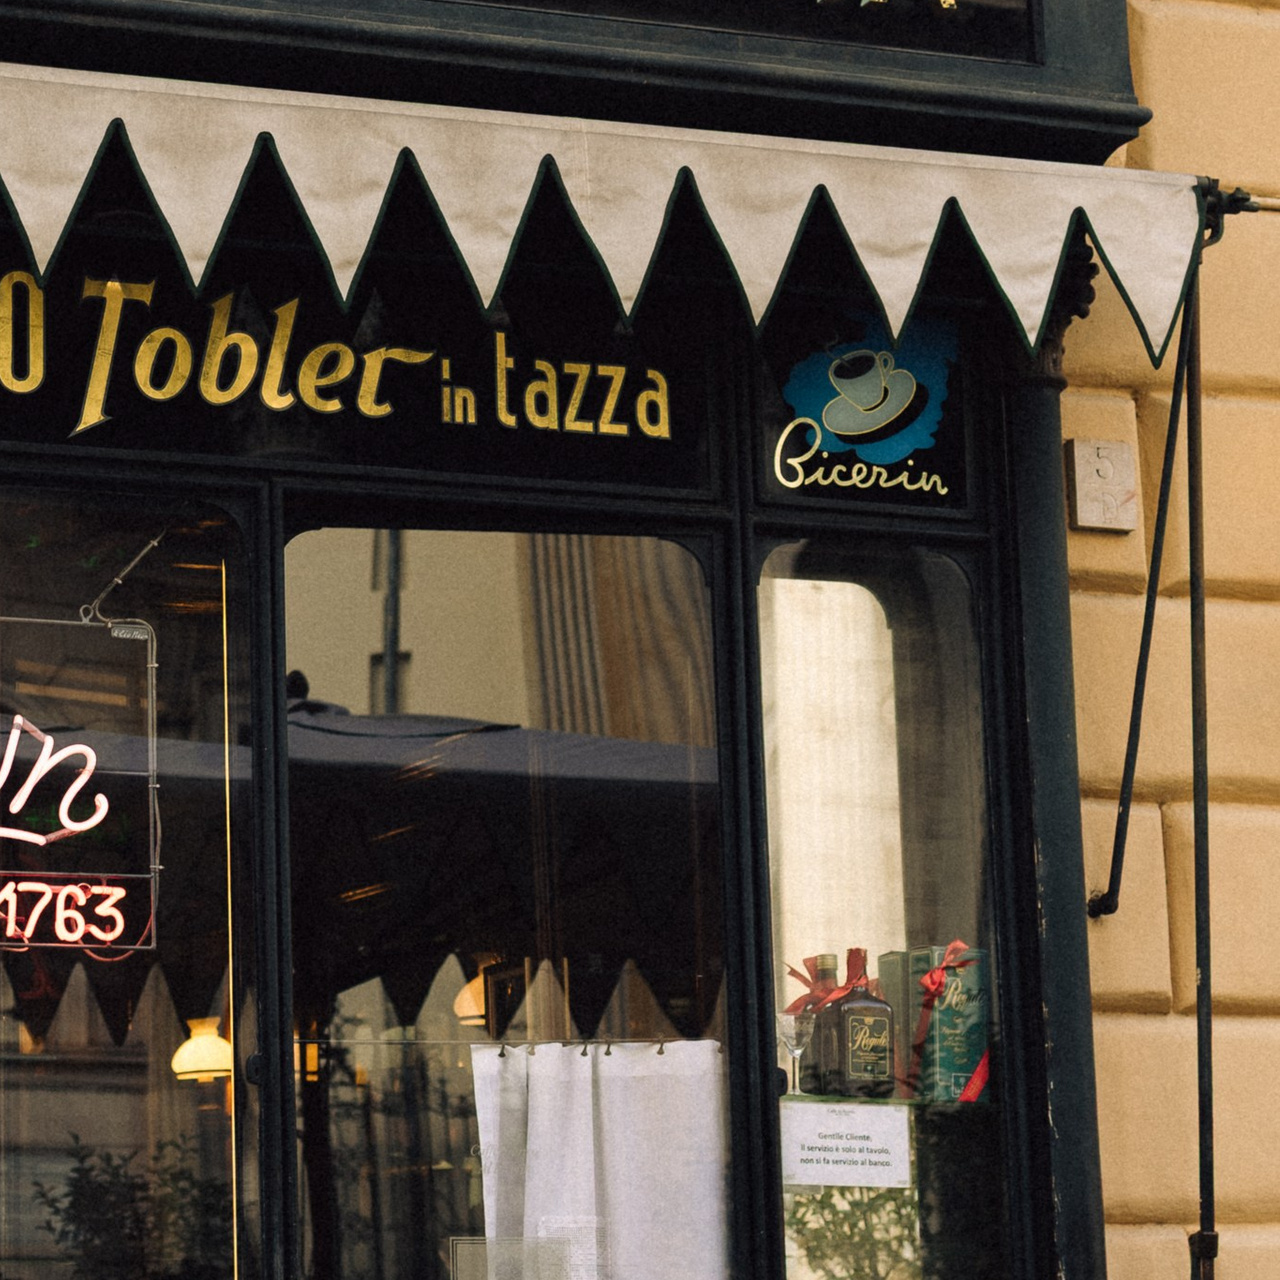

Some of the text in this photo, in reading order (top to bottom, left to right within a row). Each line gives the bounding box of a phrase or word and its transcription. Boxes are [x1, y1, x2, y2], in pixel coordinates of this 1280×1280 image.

[69, 278, 436, 438] Tobler
[441, 359, 478, 425] in
[495, 331, 672, 440] tazza
[774, 417, 949, 496] Bicerin
[1095, 447, 1115, 480] 5
[818, 1132, 845, 1141] Gentile
[841, 1145, 857, 1153] solo
[822, 1157, 830, 1165] fa
[831, 1158, 859, 1166] servizio
